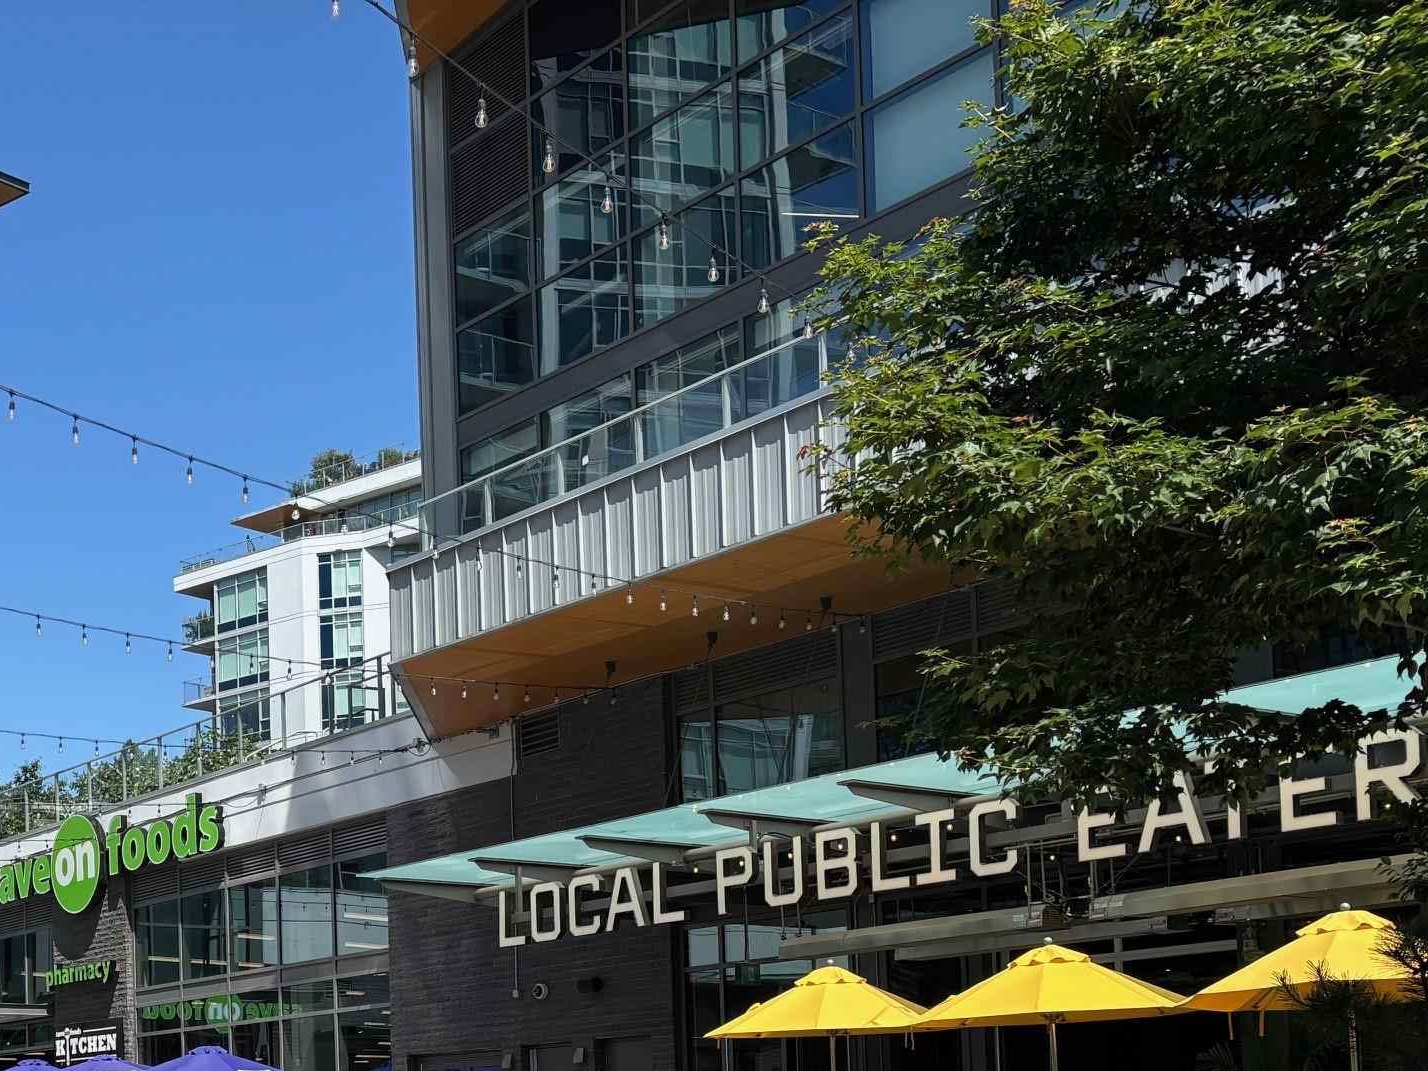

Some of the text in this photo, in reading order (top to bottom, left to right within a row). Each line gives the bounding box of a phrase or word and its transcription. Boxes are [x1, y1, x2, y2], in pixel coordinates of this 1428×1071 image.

[55, 841, 96, 887] on
[106, 793, 222, 876] foods
[498, 798, 1018, 948] LOCAL PUBLIC
[45, 960, 111, 992] pharmacy
